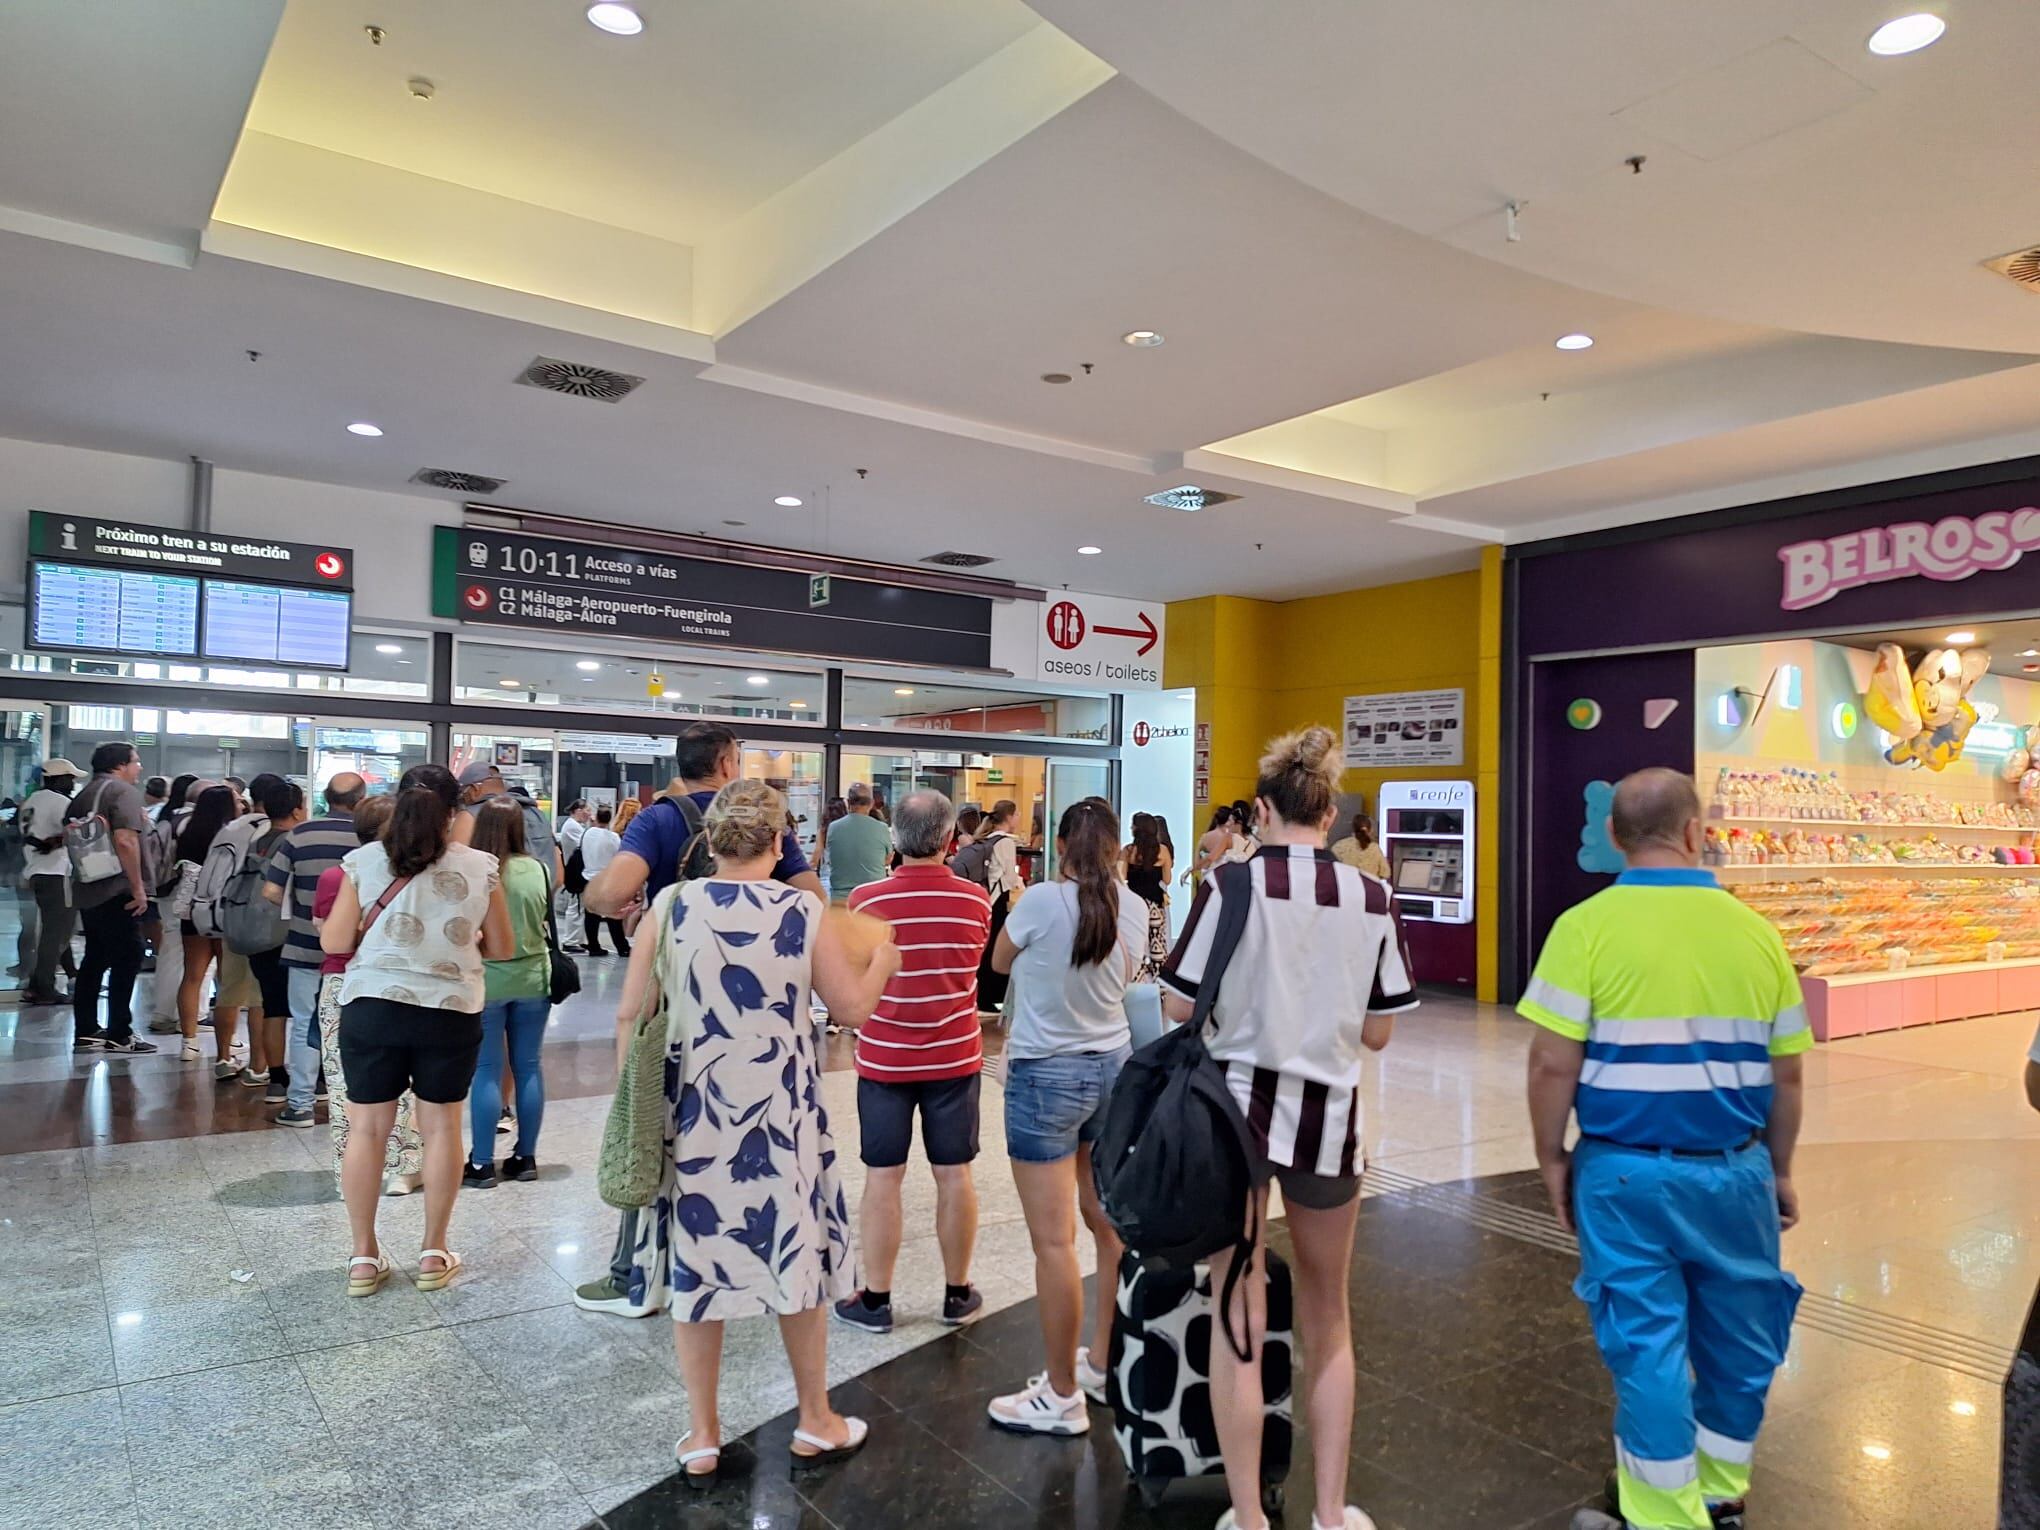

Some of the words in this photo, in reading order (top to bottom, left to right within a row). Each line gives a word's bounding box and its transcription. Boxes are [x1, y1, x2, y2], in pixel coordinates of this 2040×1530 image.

[96, 526, 159, 546] Próximo
[162, 534, 193, 549] tren
[197, 540, 207, 551] a
[210, 542, 227, 553] su
[231, 544, 290, 561] estación
[95, 545, 119, 555] NEXT
[120, 548, 147, 558] TRAIN
[149, 550, 160, 560] TO
[161, 552, 186, 563] YOUR
[187, 555, 222, 566] STATION
[1779, 512, 2013, 609] BELROS
[585, 556, 632, 573] Acceso
[637, 565, 645, 575] a
[649, 564, 678, 580] vías
[585, 573, 631, 586] PLATFORMS
[499, 587, 516, 600] C1
[499, 602, 516, 615] C2
[681, 625, 703, 634] LOCAL
[704, 627, 730, 637] TRAINS
[1044, 660, 1091, 676] aseos
[1105, 663, 1157, 682] toilets
[1420, 785, 1464, 806] renfe
